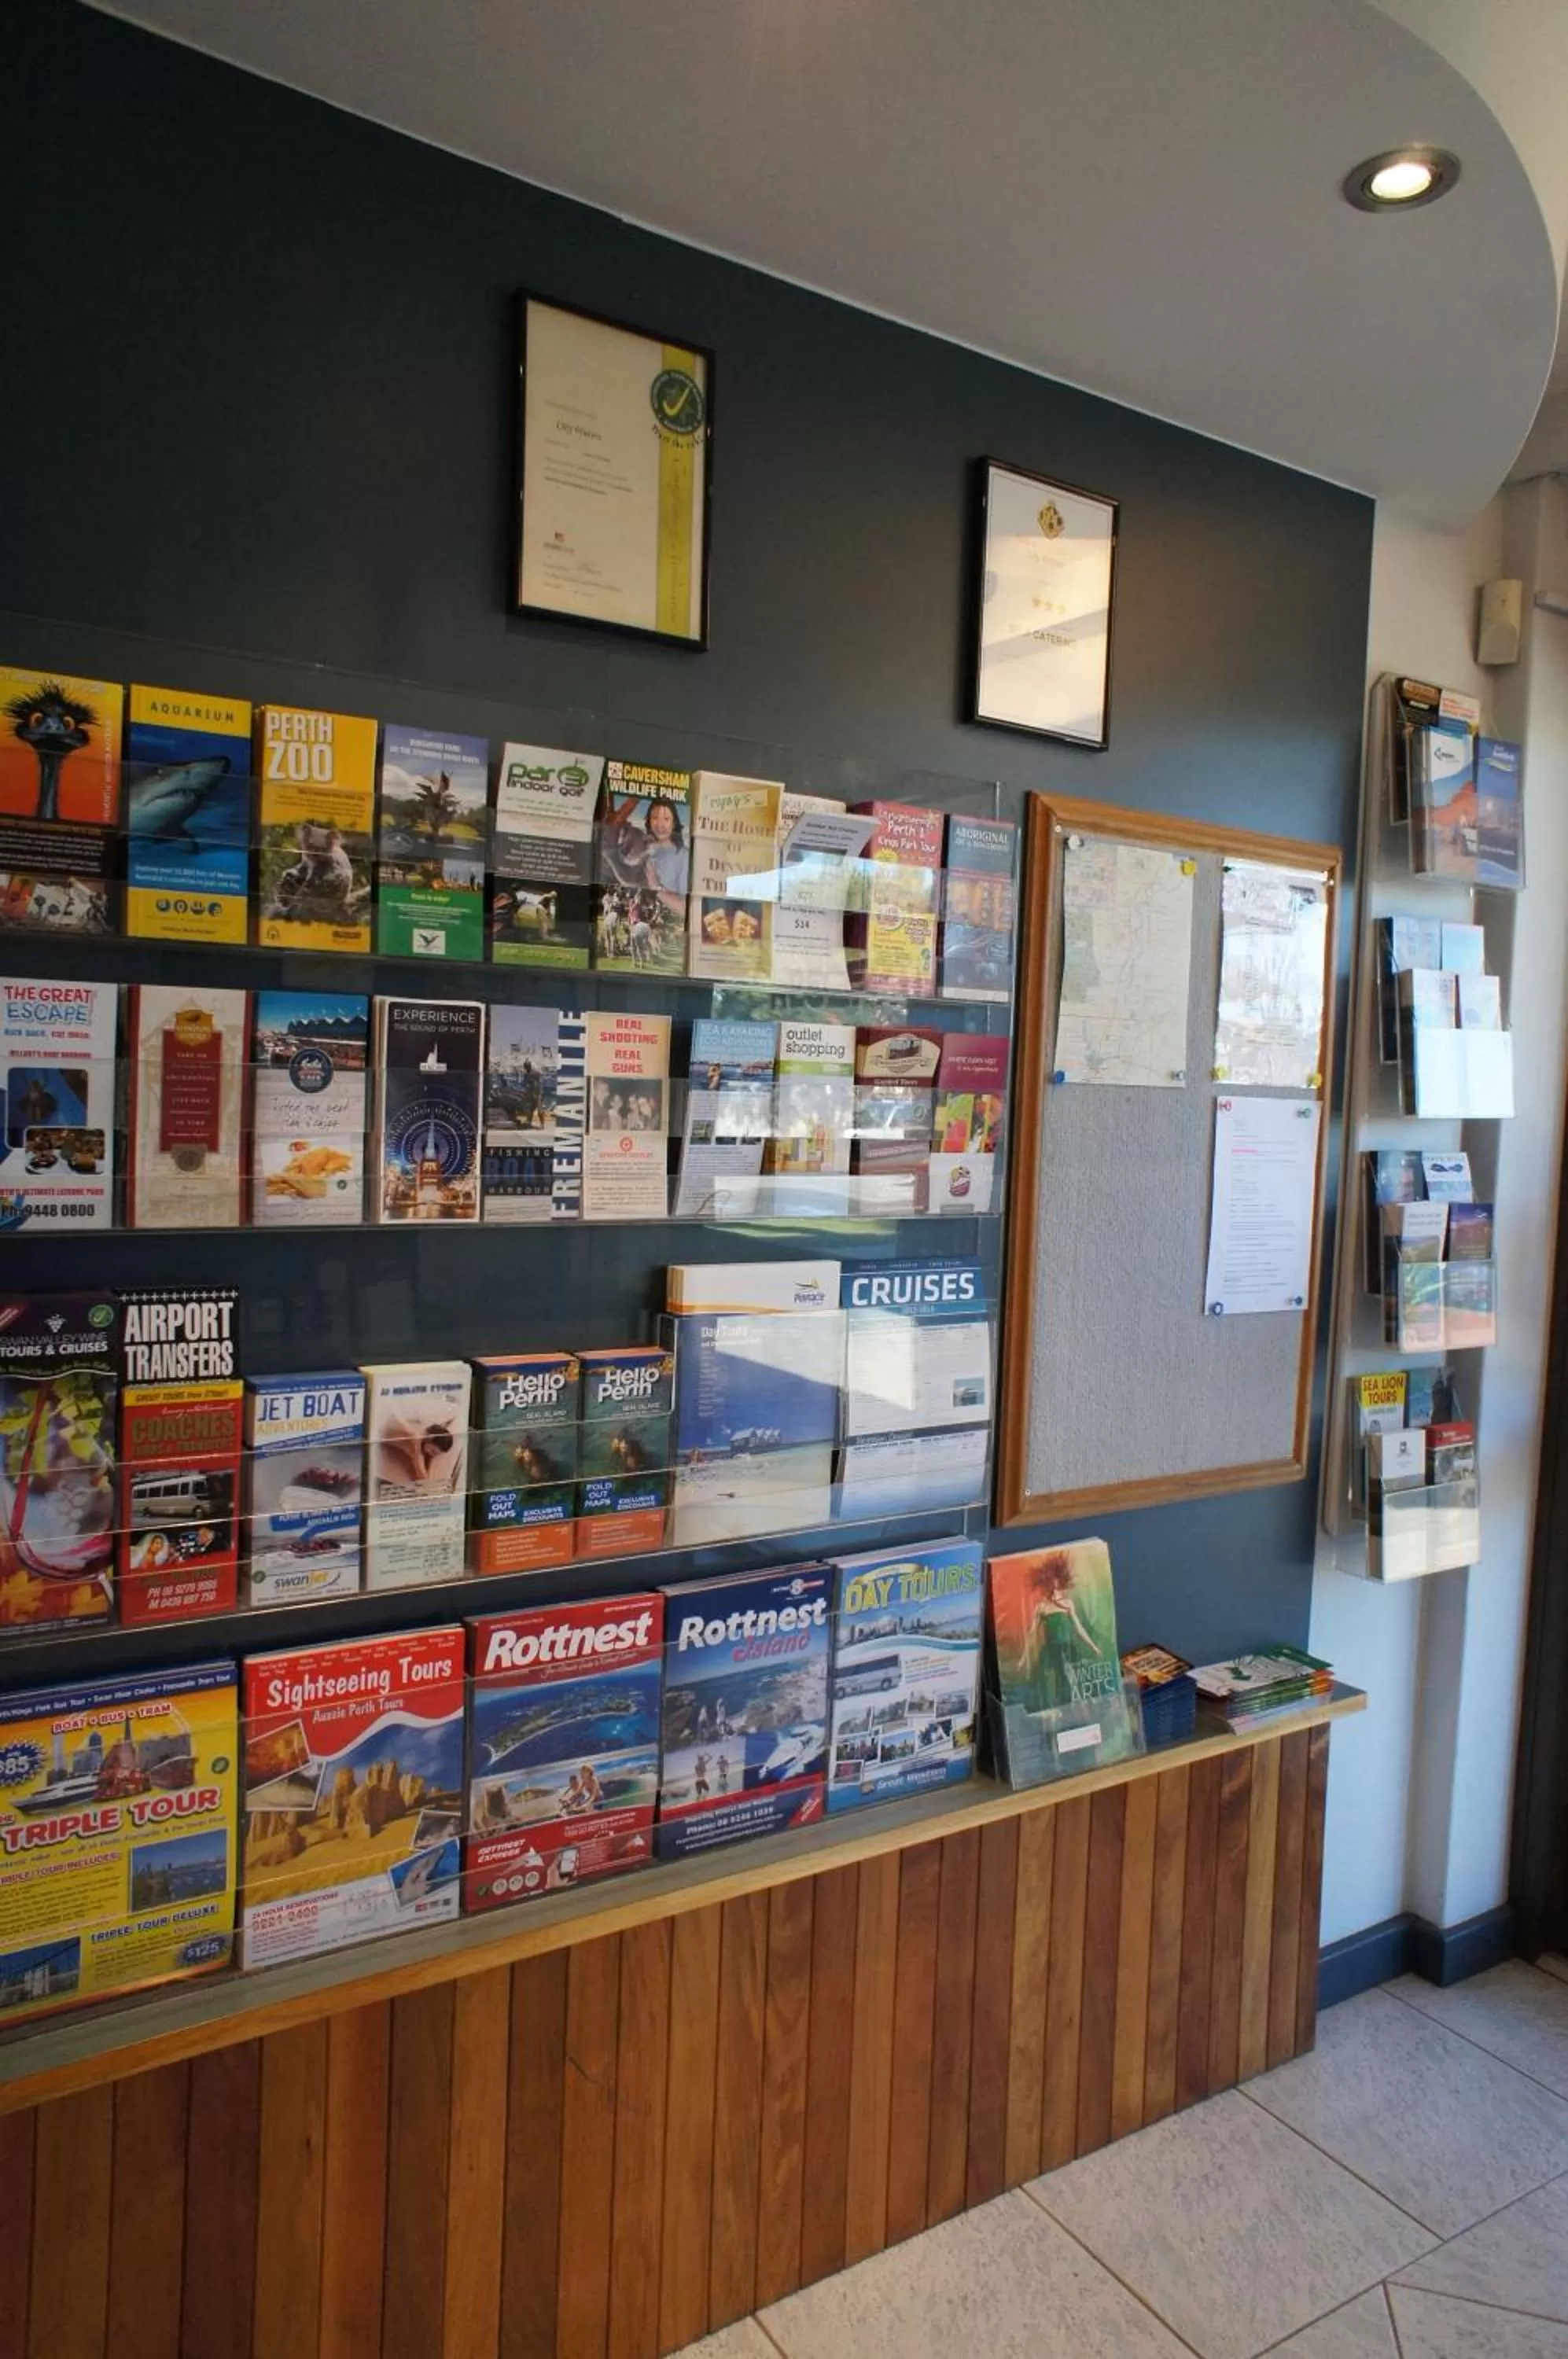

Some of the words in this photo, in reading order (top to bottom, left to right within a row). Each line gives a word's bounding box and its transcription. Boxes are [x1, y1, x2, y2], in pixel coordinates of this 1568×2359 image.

[149, 700, 235, 723] AQUARIUM
[267, 711, 333, 743] PERTH
[267, 743, 334, 782] ZOO
[623, 764, 690, 787] CAVERSHAM
[609, 780, 657, 798] WILDLIFE
[659, 788, 687, 803] PARK
[4, 985, 36, 1000] THE
[39, 986, 92, 1003] GREAT
[6, 1001, 88, 1022] ESCAPE
[393, 1008, 476, 1024] EXPERIENCE
[616, 1018, 642, 1030] REAL
[786, 1028, 823, 1041] outlet
[600, 1032, 659, 1045] SHOOTING
[786, 1040, 845, 1058] shopping
[614, 1049, 642, 1061] REAL
[611, 1063, 643, 1073] GUNS
[553, 1010, 587, 1220] FREMANTLE
[852, 1272, 975, 1307] CRUISES
[123, 1301, 234, 1344] AIRPORT
[0, 1345, 42, 1357] TOURS
[46, 1344, 56, 1356] &
[59, 1340, 109, 1354] CRUISES
[123, 1340, 234, 1382] TRANSFERS
[506, 1373, 566, 1394] Hello
[604, 1367, 661, 1386] Hello
[1362, 1378, 1379, 1392] SEA
[1382, 1376, 1404, 1389] LION
[499, 1386, 558, 1411] Perth
[597, 1378, 652, 1404] Perth
[1367, 1389, 1398, 1405] TOURS
[257, 1396, 294, 1422] JET
[303, 1391, 360, 1418] BOAT
[131, 1408, 235, 1445] COACHES
[490, 1493, 516, 1503] FOLD
[586, 1481, 613, 1492] FOLD
[588, 1490, 609, 1500] OUT
[491, 1501, 512, 1512] OUT
[584, 1498, 611, 1509] MAPS
[488, 1511, 517, 1522] MAPS
[844, 1576, 894, 1614] DAY
[898, 1562, 977, 1604] TOURS
[677, 1596, 827, 1653] Rottnest
[484, 1610, 654, 1672] Rottnest
[267, 1665, 392, 1711] Sightseeing
[399, 1655, 453, 1684] Tours
[1063, 1659, 1113, 1684] WINTER
[1070, 1676, 1116, 1703] ARTS
[53, 1717, 86, 1733] BOAT
[100, 1712, 126, 1727] BUS
[138, 1704, 171, 1719] TRAM
[3, 1805, 122, 1853] TRIPLE
[131, 1787, 219, 1827] TOUR
[90, 1926, 133, 1945] TRIPLE
[137, 1916, 170, 1933] TOUR
[186, 1941, 221, 1960] $125
